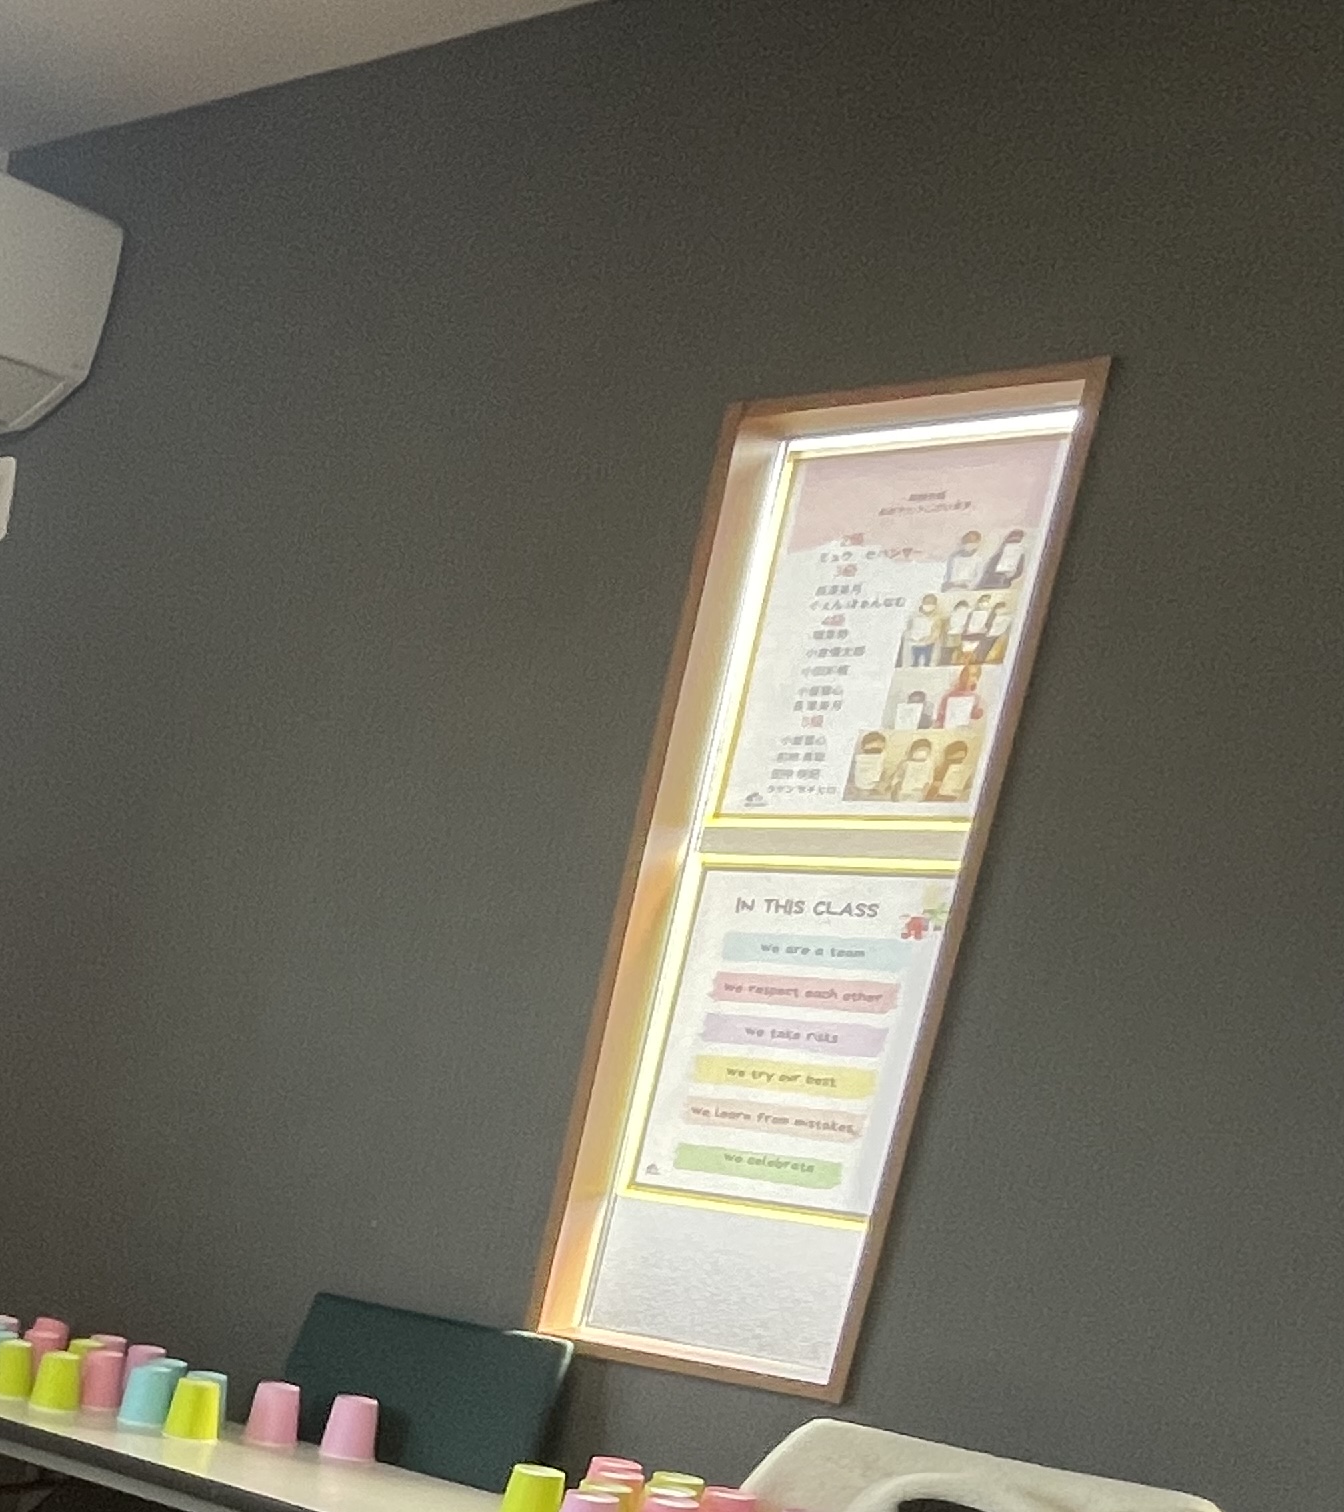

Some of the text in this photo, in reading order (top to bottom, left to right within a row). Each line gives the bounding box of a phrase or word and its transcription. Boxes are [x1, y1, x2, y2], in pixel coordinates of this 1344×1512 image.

[736, 897, 880, 918] IN THIS CLASS
[785, 945, 811, 956] are
[814, 947, 825, 957] a
[830, 947, 866, 958] team
[723, 982, 884, 1002] we respect each other
[744, 1027, 839, 1044] we take risks
[726, 1067, 838, 1088] we try our best
[690, 1106, 711, 1118] we
[714, 1107, 752, 1121] learn
[756, 1112, 790, 1125] from
[723, 1151, 815, 1172] we celebrate
